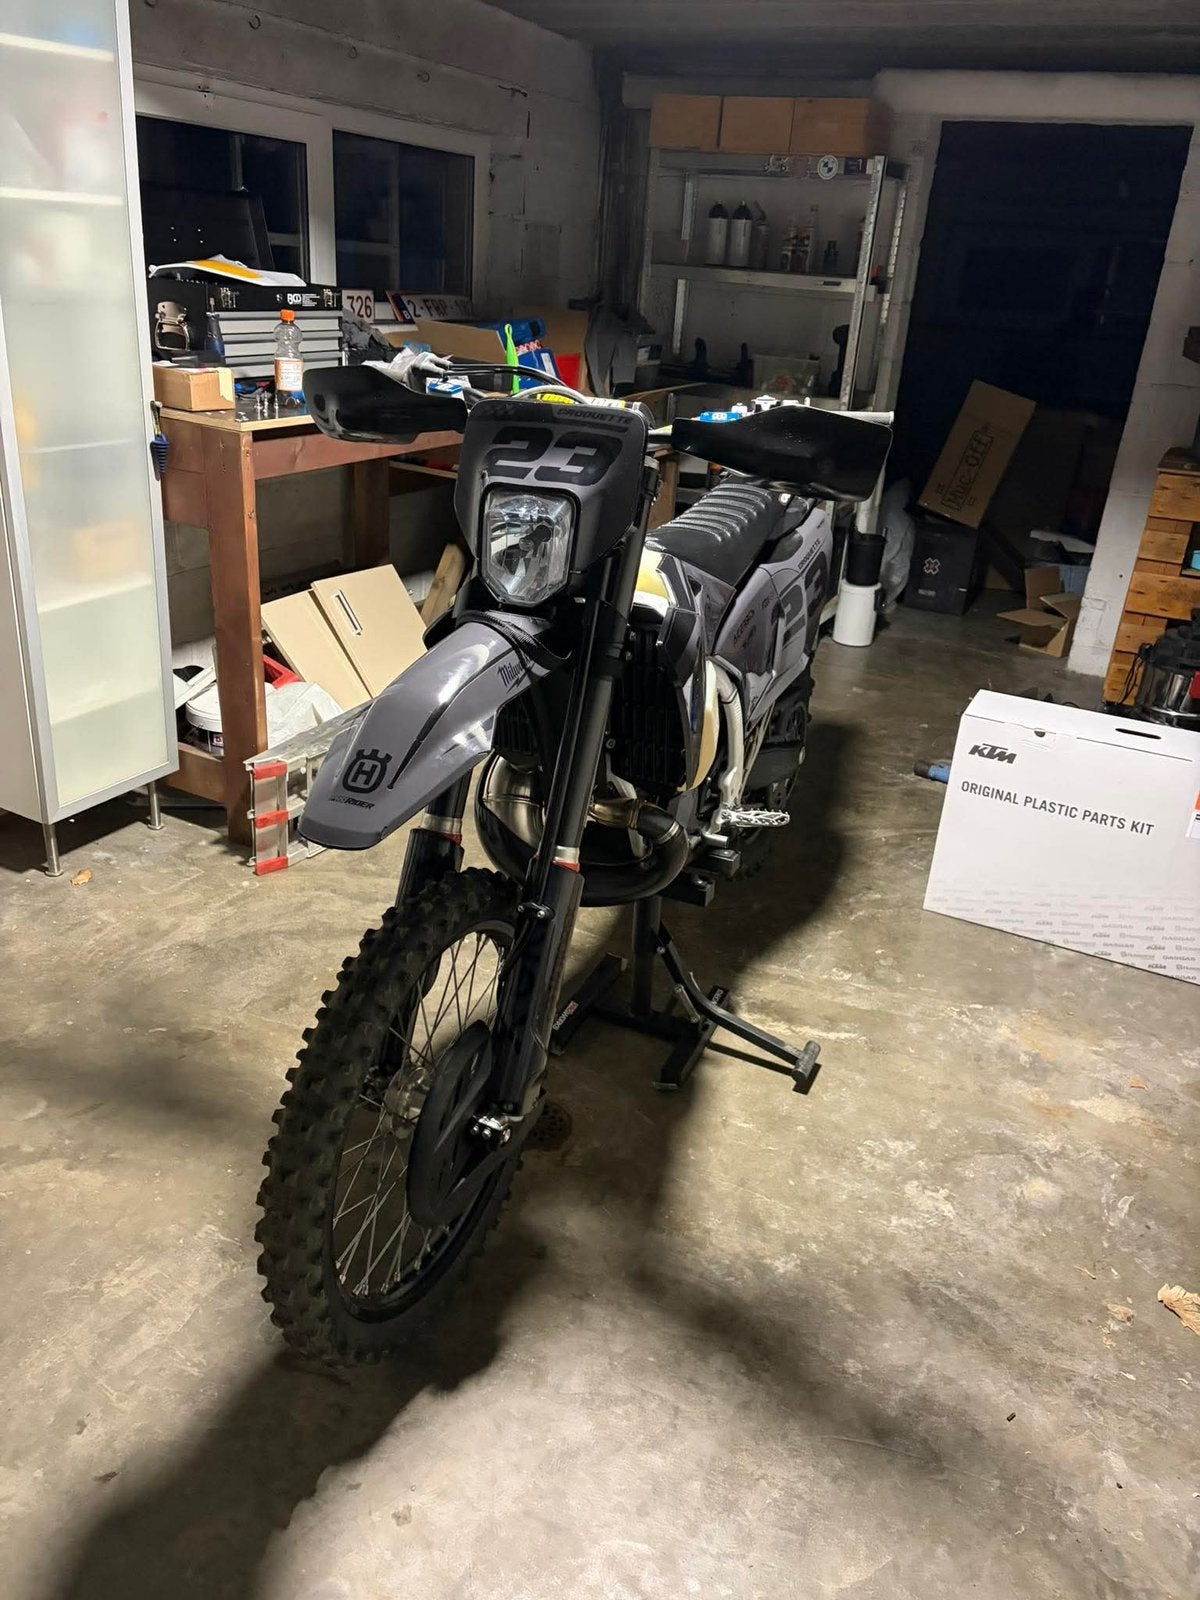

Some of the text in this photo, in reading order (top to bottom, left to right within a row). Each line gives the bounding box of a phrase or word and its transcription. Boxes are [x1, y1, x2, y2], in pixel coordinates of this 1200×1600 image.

[346, 295, 372, 318] 326
[557, 408, 634, 425] CROQUETTE
[484, 426, 624, 486] 23
[968, 743, 1018, 765] KTM
[961, 780, 1155, 836] ORIGINAL PLASTIC PARTS KIT
